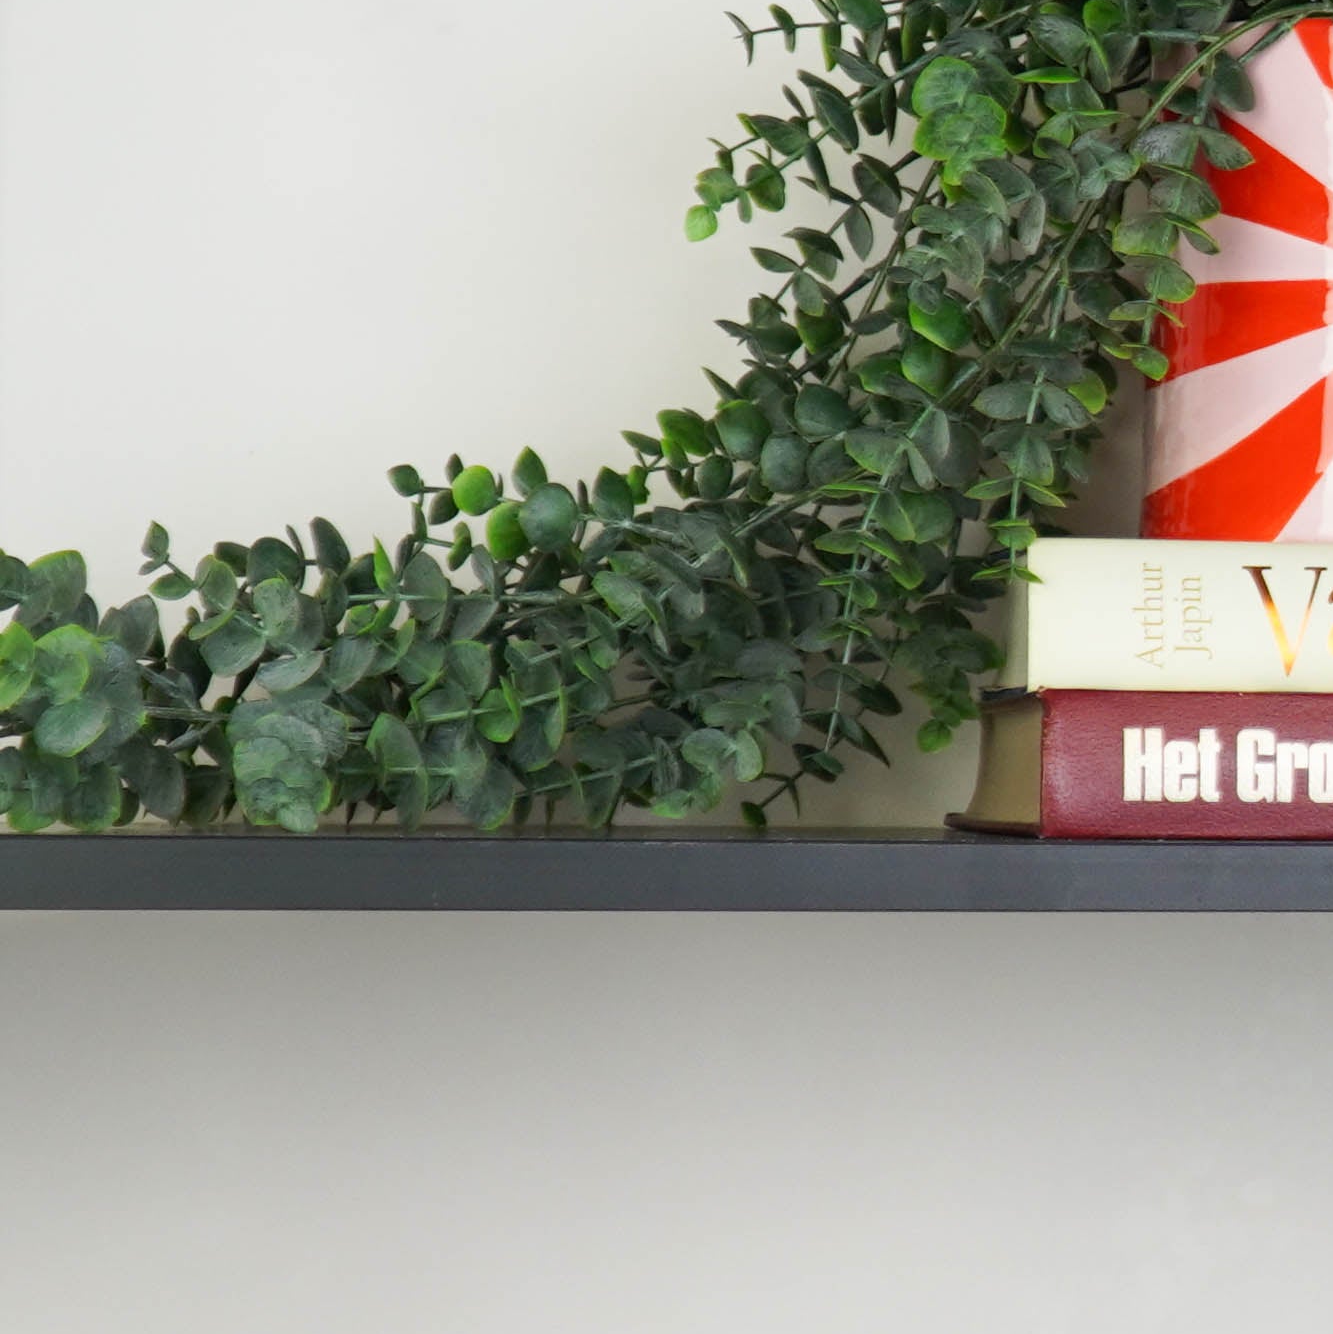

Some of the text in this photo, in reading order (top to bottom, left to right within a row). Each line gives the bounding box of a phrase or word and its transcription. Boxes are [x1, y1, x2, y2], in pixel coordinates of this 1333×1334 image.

[1133, 562, 1164, 668] Arthur
[1174, 576, 1212, 660] Japin
[1122, 728, 1222, 803] Het
